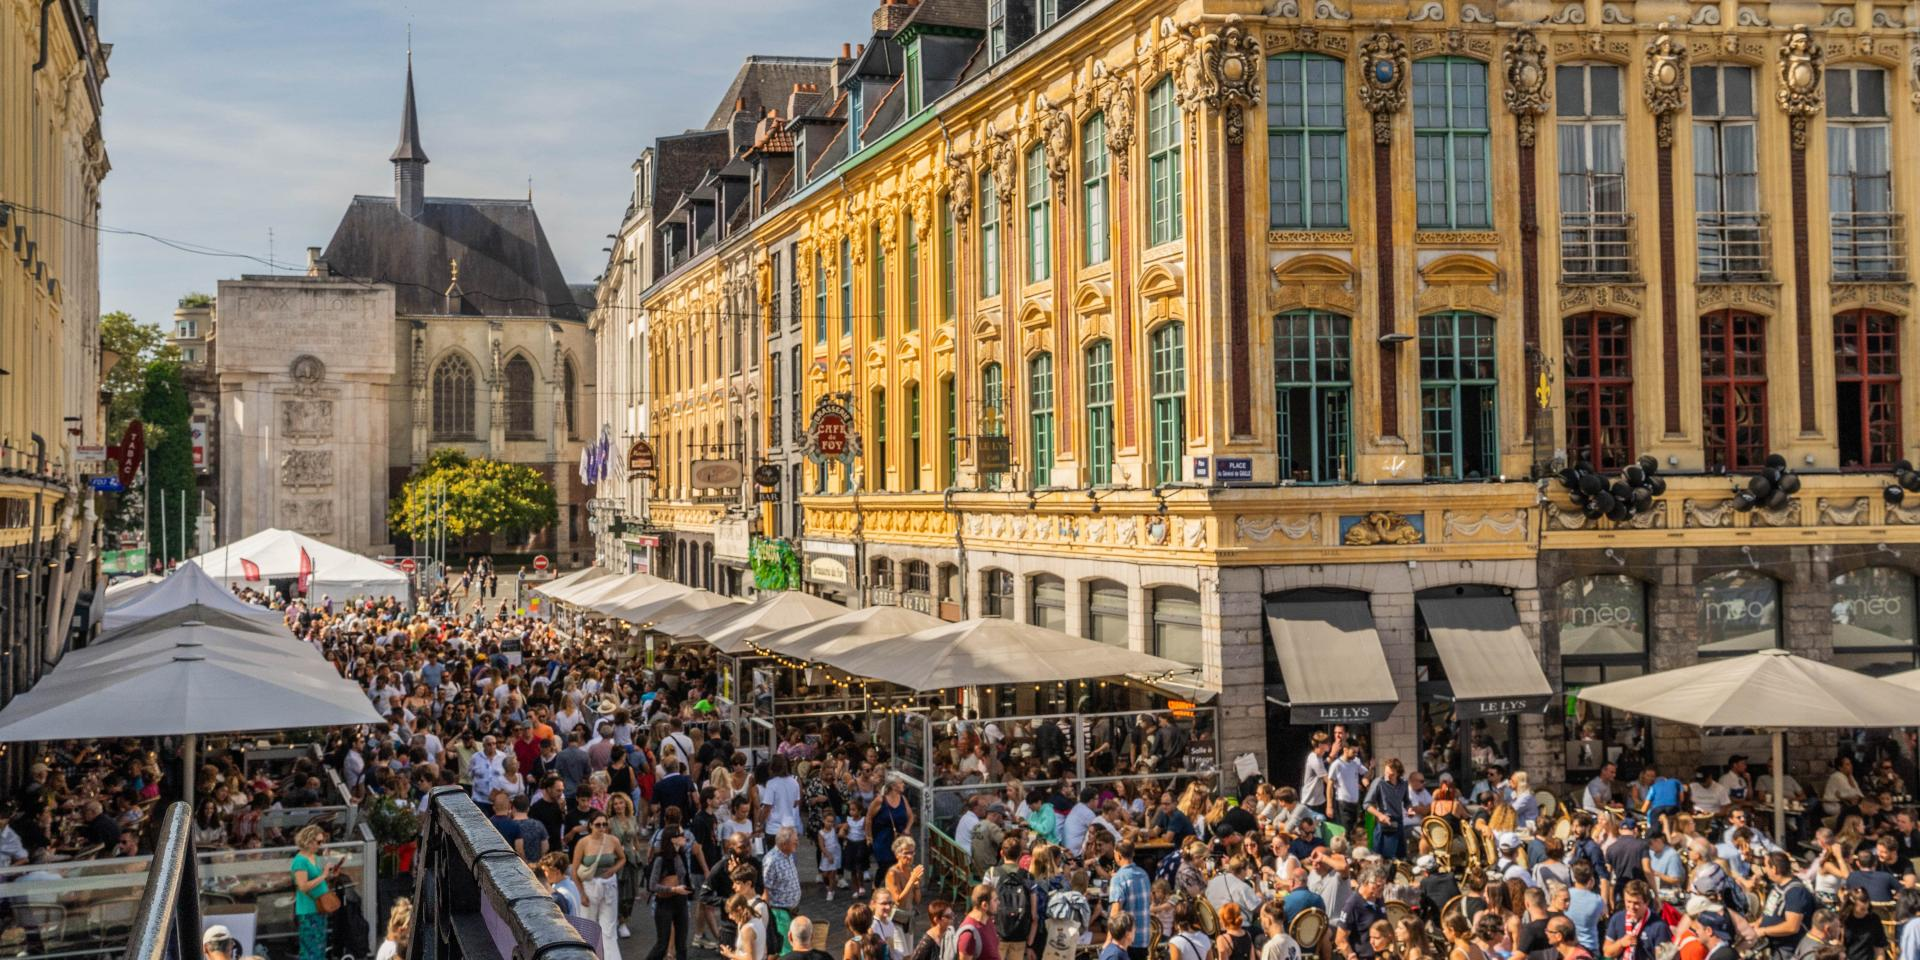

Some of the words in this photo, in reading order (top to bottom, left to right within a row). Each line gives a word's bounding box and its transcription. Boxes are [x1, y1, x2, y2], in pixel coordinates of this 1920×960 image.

[814, 406, 850, 422] BRASSERIE
[822, 440, 843, 450] FOY
[124, 433, 137, 474] TABAC
[760, 493, 778, 501] BAR
[1480, 702, 1498, 712] LE
[1501, 700, 1527, 710] LYS
[1320, 709, 1338, 717] LE
[1343, 707, 1370, 717] LYS
